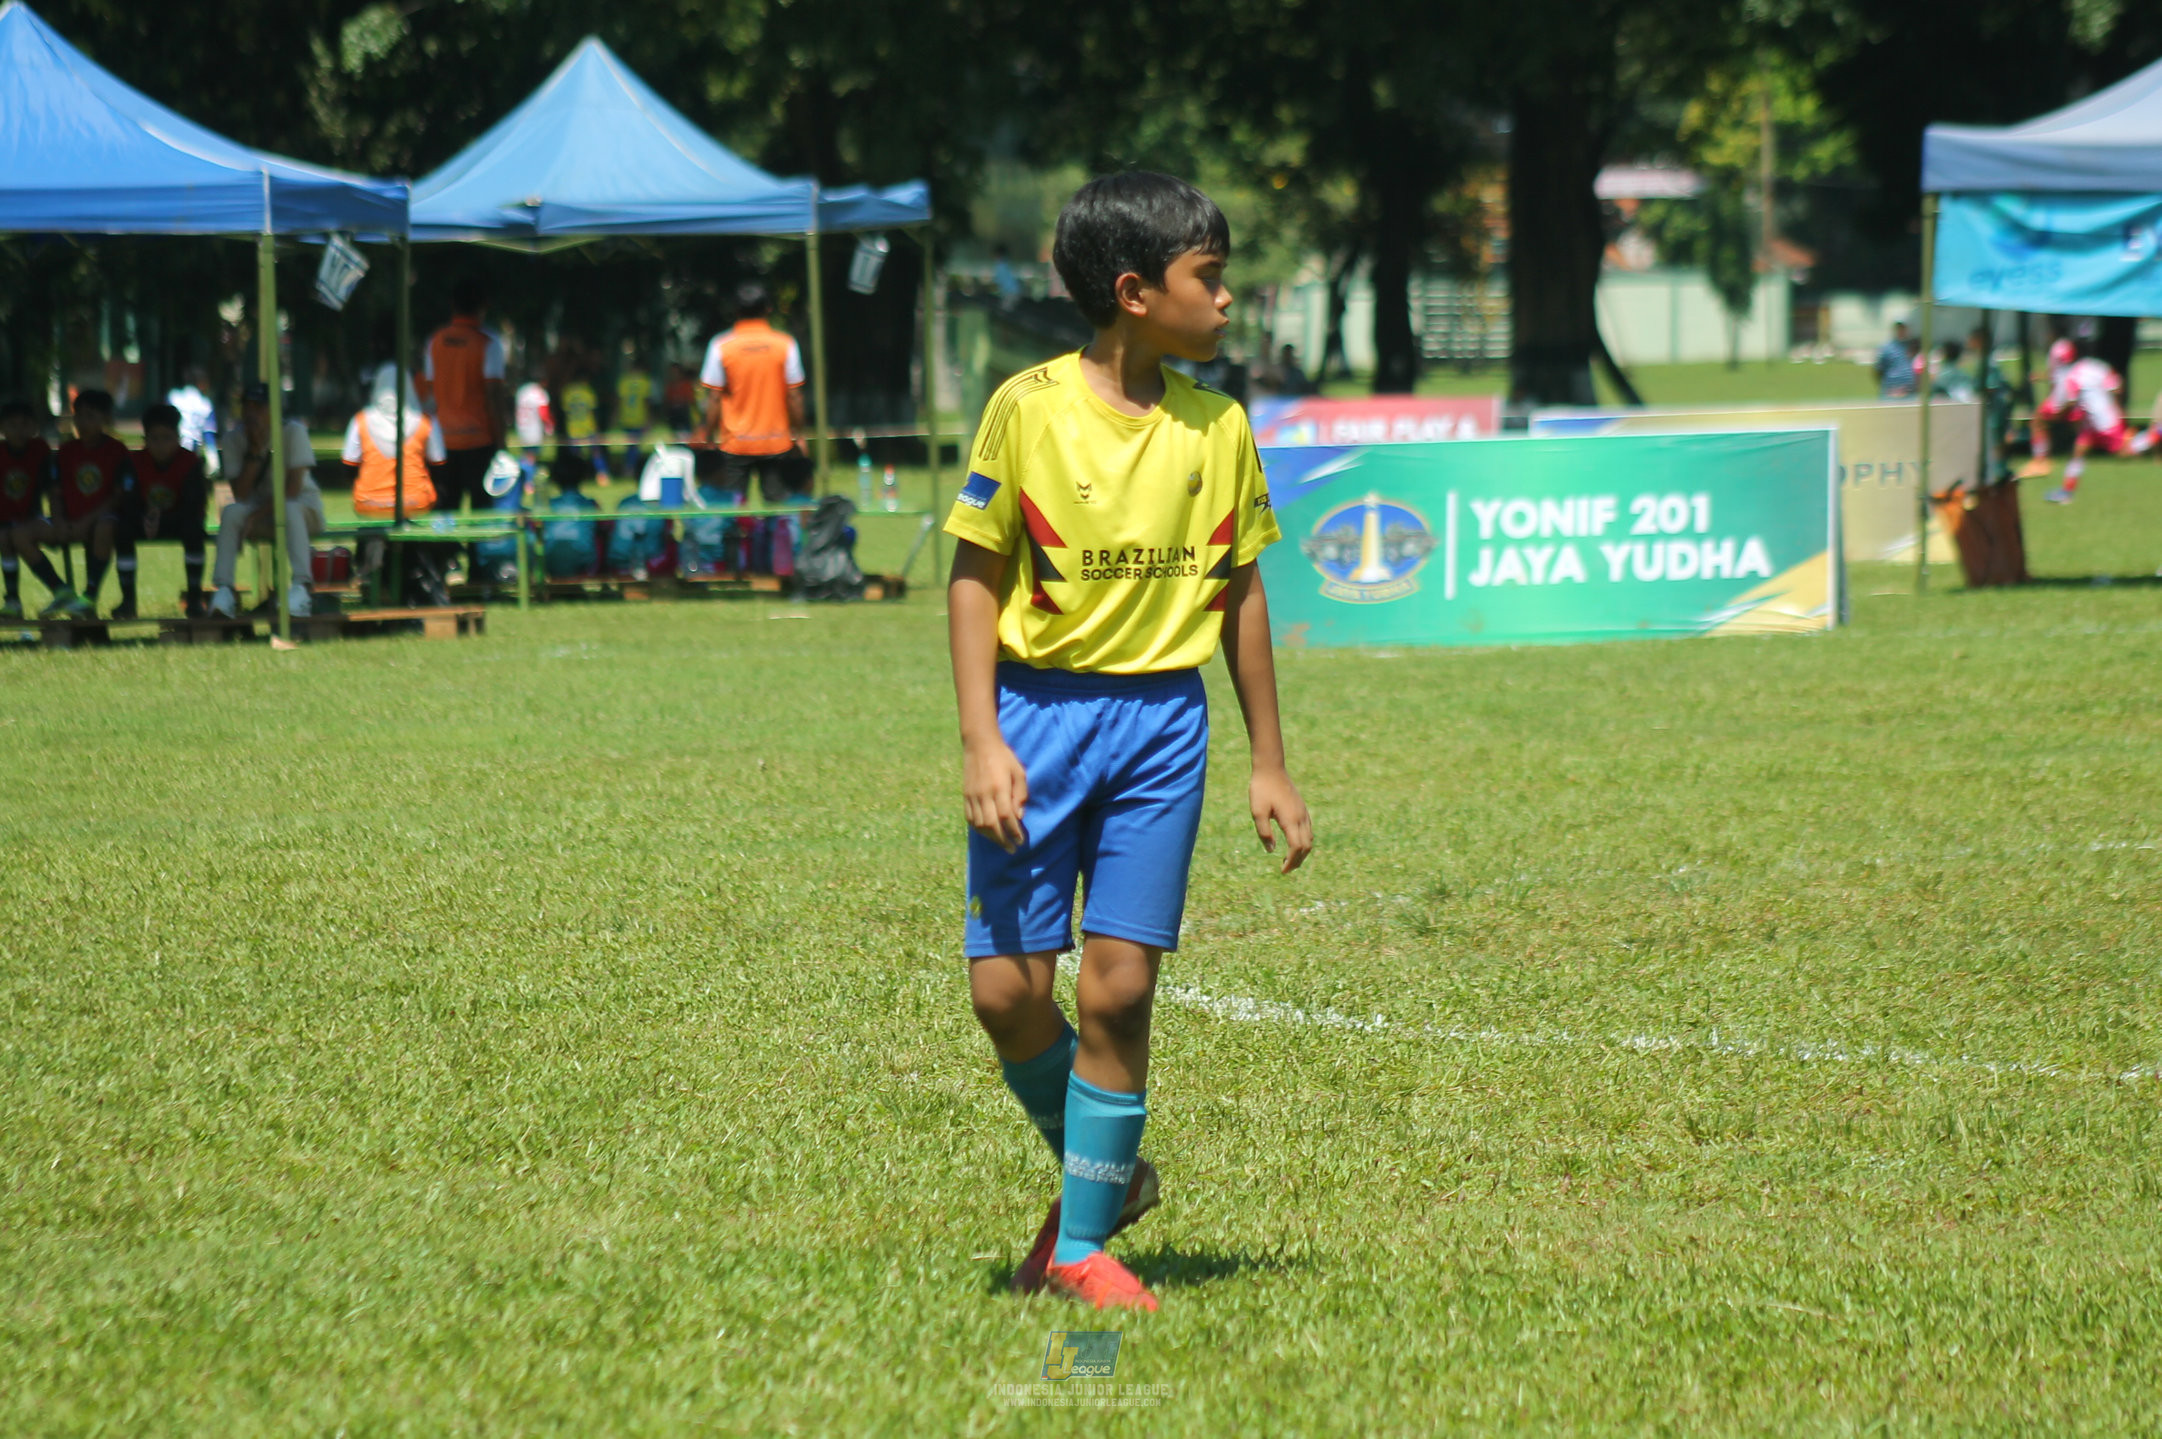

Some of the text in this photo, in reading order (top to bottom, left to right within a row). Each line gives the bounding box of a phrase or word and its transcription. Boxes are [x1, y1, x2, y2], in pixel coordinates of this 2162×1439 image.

[1469, 492, 1710, 539] YONIF 201
[1081, 564, 1198, 581] SOCCER SCHOOLS
[1082, 546, 1195, 567] BRAZILIAN
[1468, 536, 1773, 587] JAYA YUDHA
